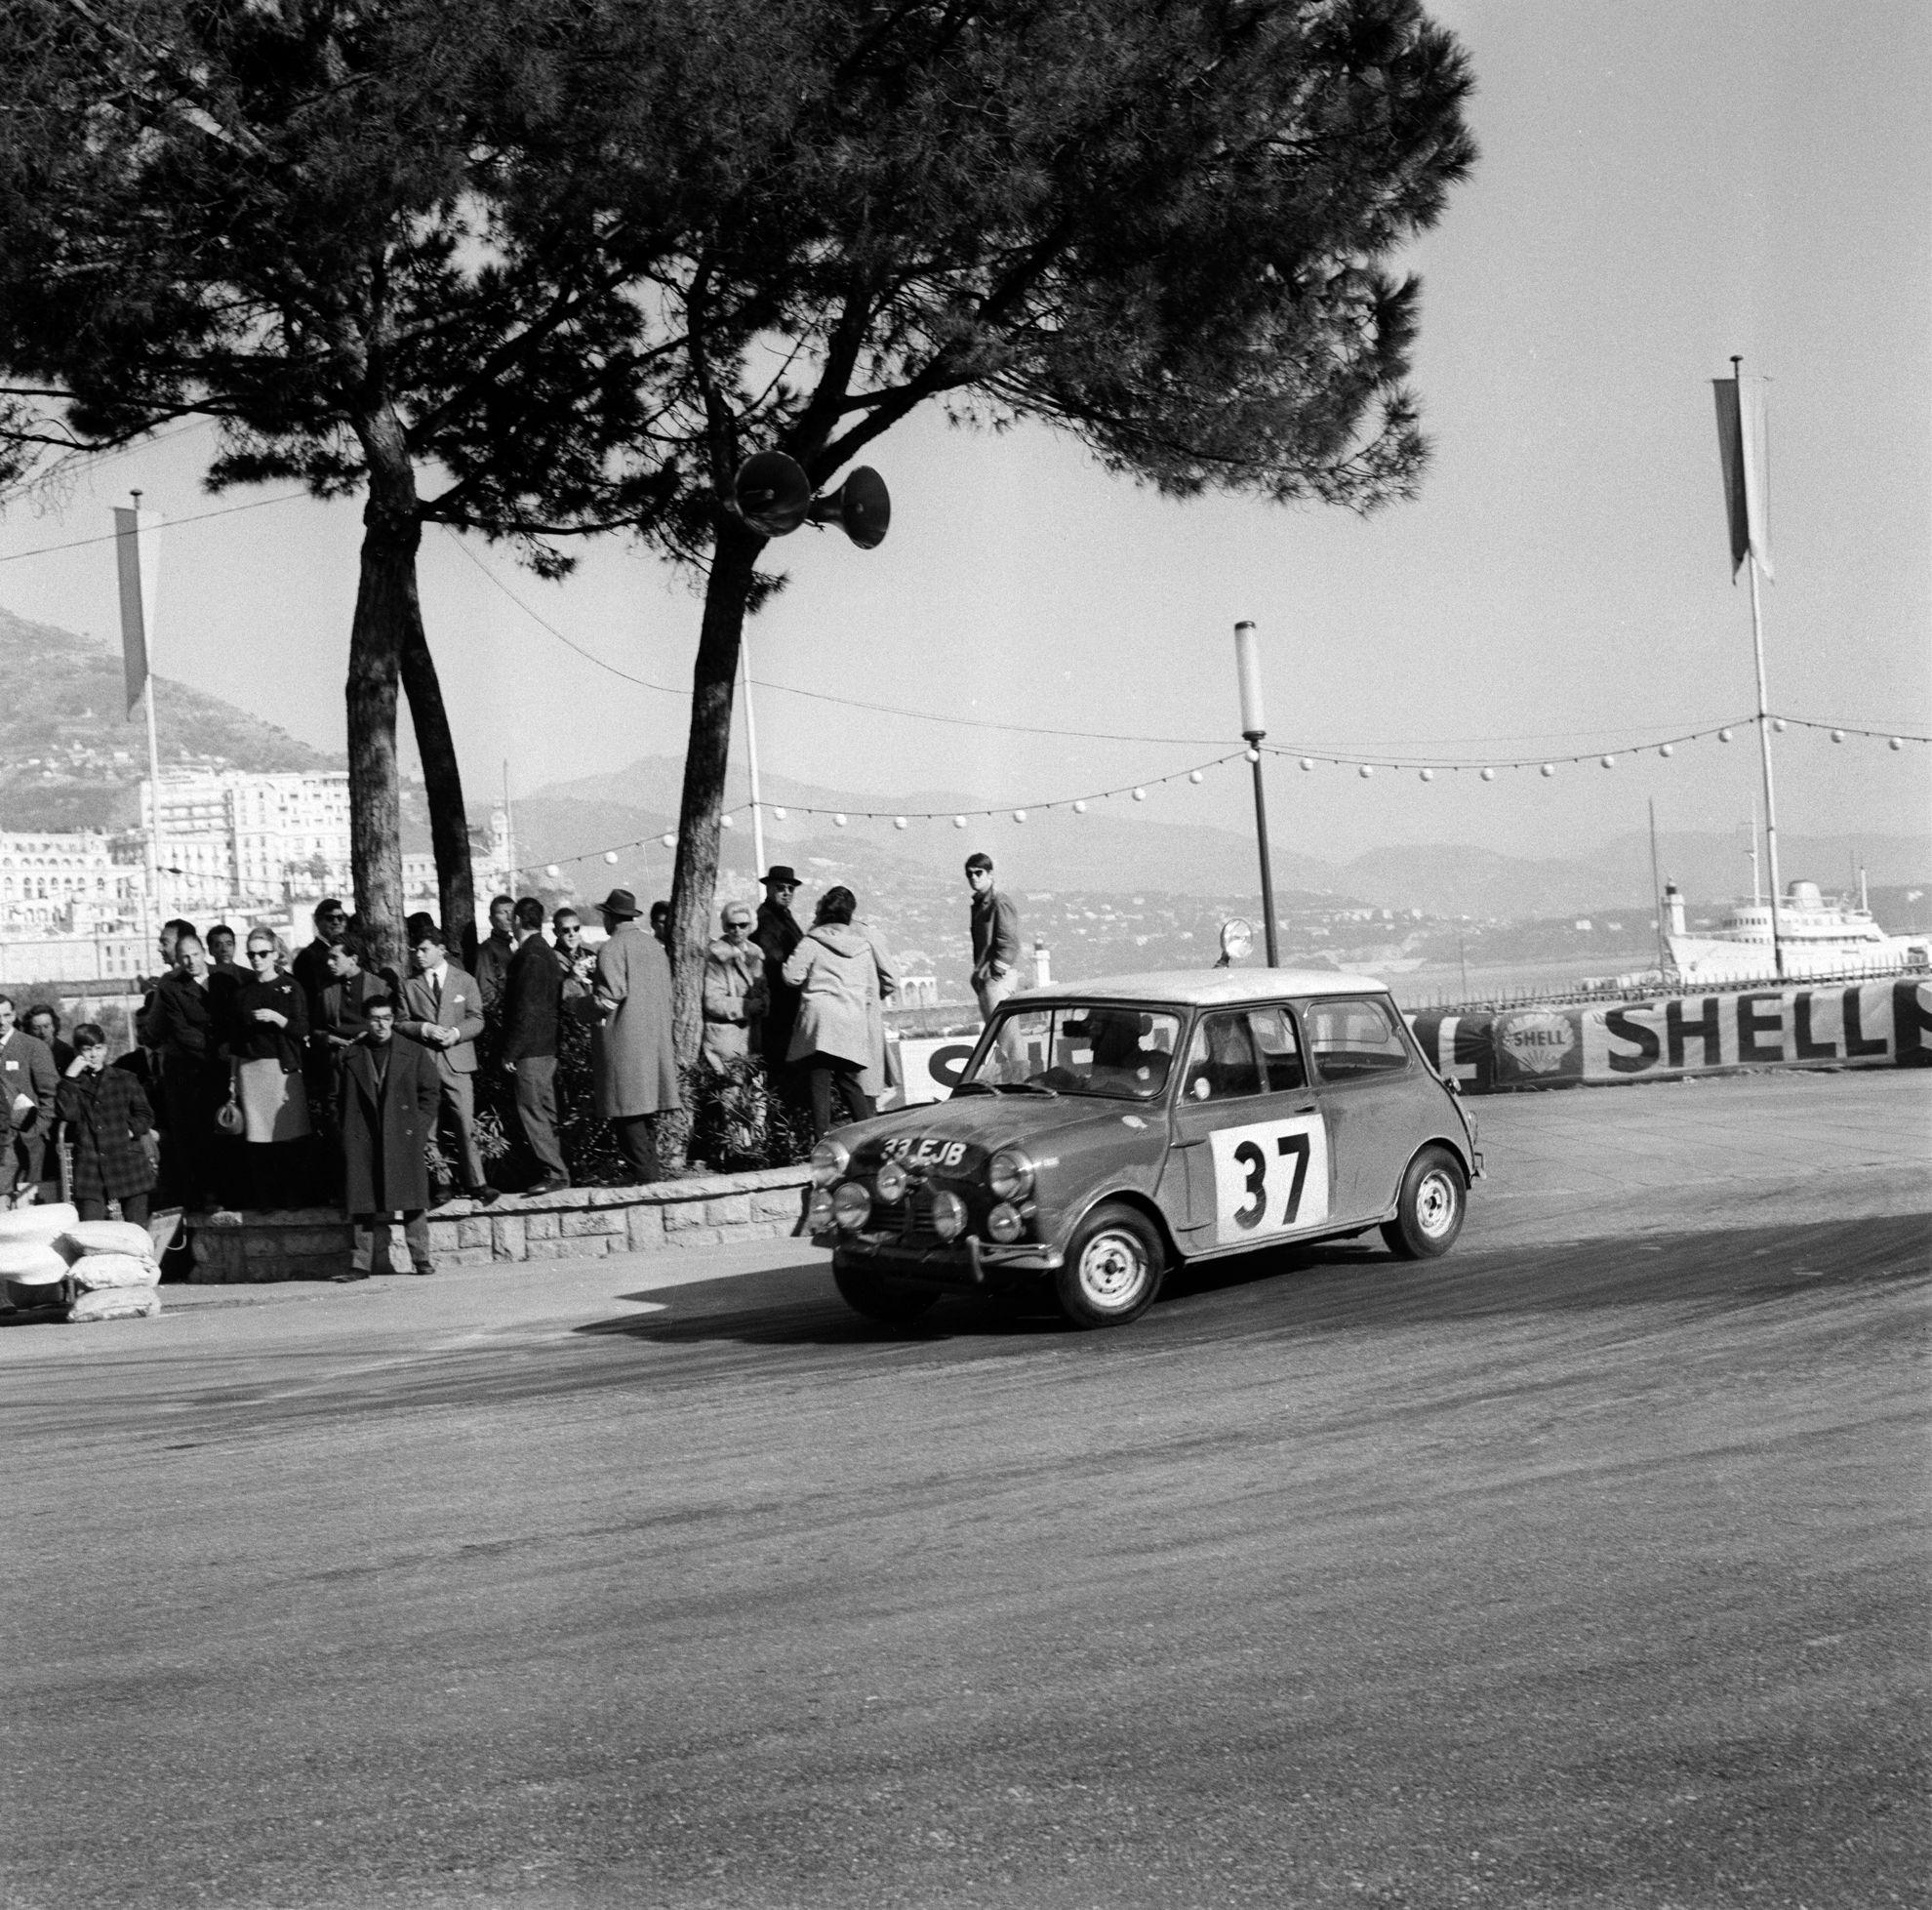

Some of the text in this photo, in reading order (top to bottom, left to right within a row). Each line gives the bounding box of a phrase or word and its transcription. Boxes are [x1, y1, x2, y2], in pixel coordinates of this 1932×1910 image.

[1512, 1030, 1565, 1047] SHELL
[1605, 984, 1888, 1073] SHELL
[916, 1139, 967, 1166] EJB
[1233, 1132, 1310, 1230] 37
